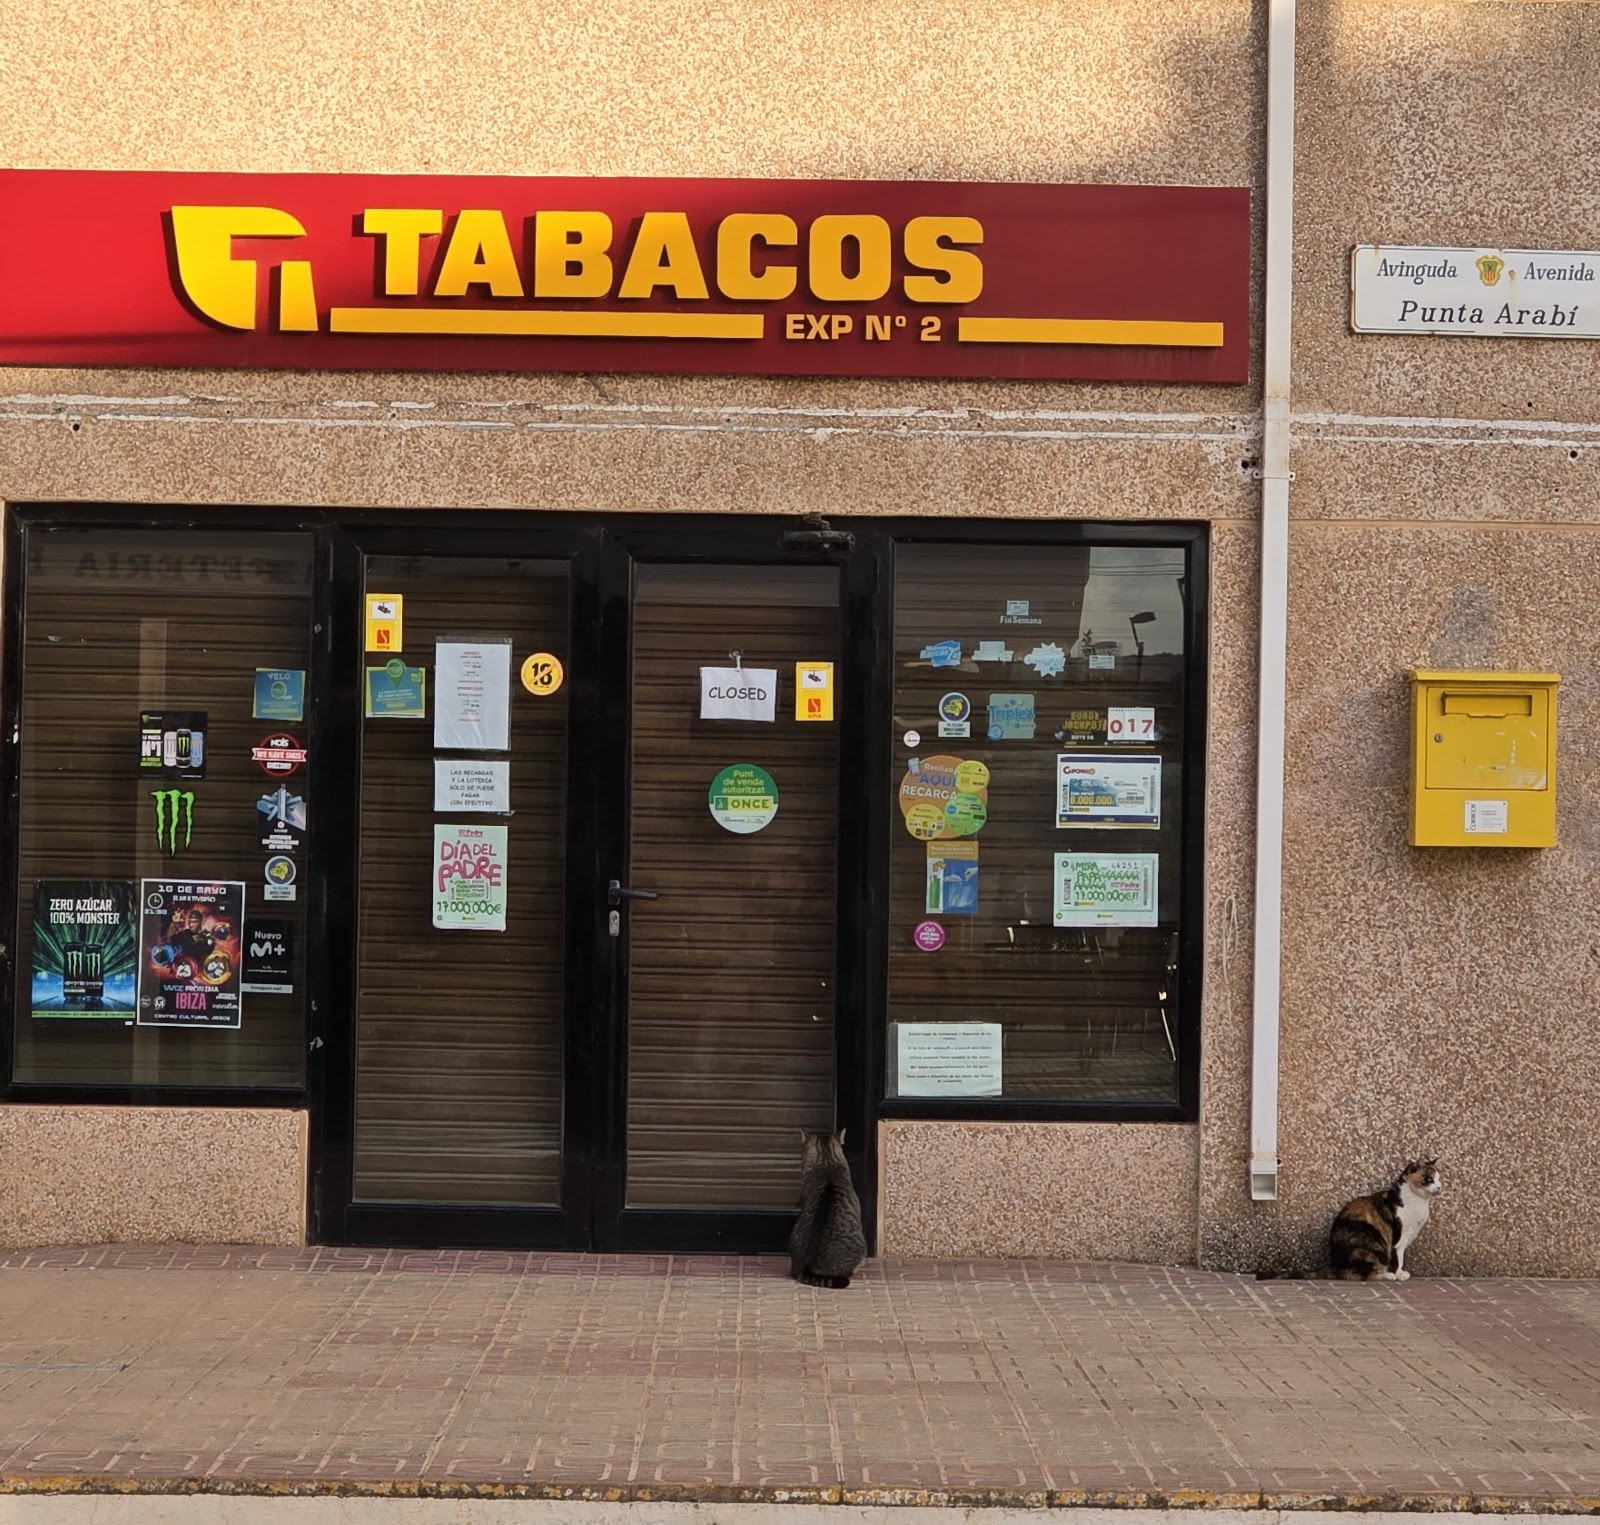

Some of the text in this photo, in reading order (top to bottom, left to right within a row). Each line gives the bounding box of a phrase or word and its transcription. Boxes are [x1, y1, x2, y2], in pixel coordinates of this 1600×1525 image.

[363, 208, 984, 303] TABACOS
[1376, 258, 1595, 285] Avinguda Avenida
[1398, 300, 1579, 327] Punta Arabí
[785, 314, 853, 340] EXP
[920, 316, 942, 342] 2
[267, 672, 291, 681] VELO
[708, 687, 767, 701] CLOSED
[989, 705, 1034, 721] Triplex
[733, 770, 754, 778] Punt
[924, 763, 954, 773] Realiza
[723, 778, 764, 786] de venda
[722, 786, 765, 794] autoritzat
[902, 785, 957, 800] RECARGA
[731, 799, 770, 809] ONCE
[440, 839, 497, 861] DÍA DEL
[438, 856, 502, 892] PADRE
[158, 884, 227, 895] 10 DE MAYO
[1119, 881, 1140, 889] Padre
[49, 896, 113, 912] ZERO AZÚCAR
[49, 912, 120, 925] 100% MONSTER
[254, 931, 282, 940] Nuevo
[175, 992, 207, 1010] IBIZA
